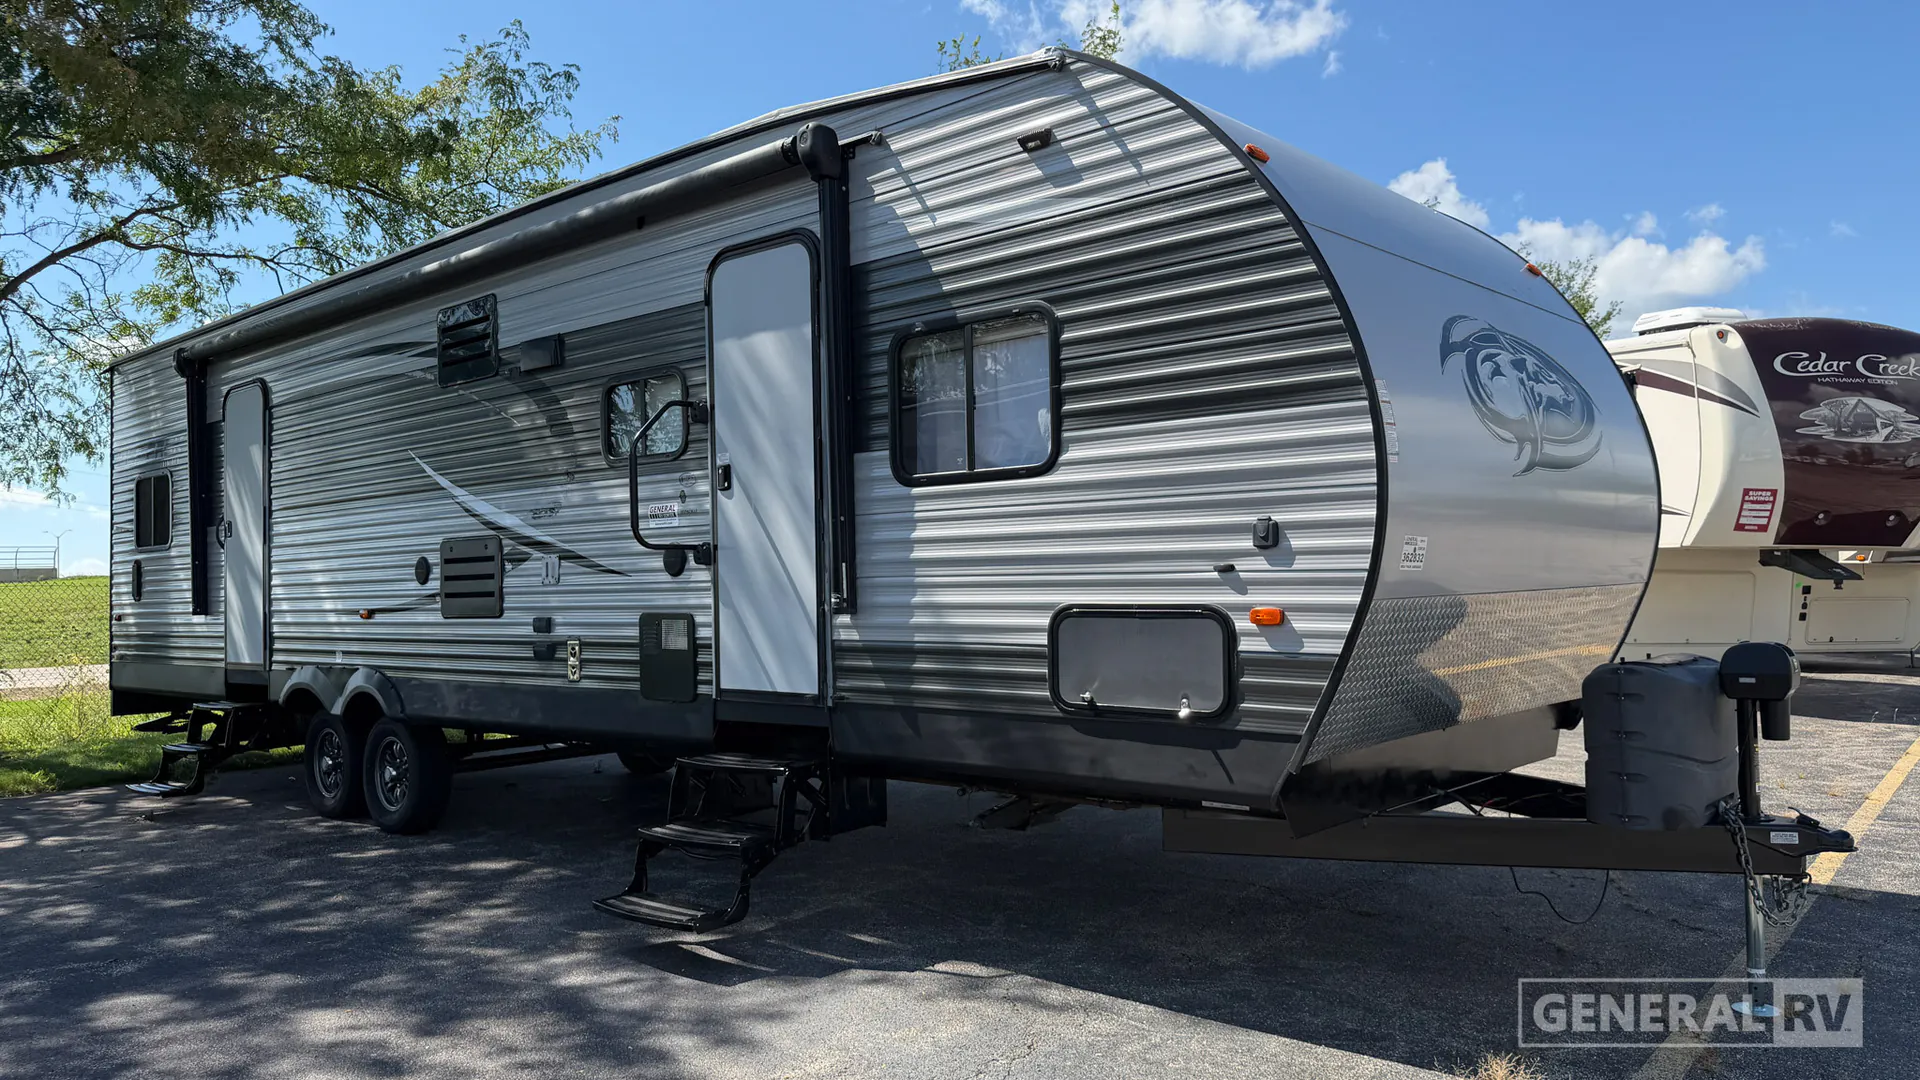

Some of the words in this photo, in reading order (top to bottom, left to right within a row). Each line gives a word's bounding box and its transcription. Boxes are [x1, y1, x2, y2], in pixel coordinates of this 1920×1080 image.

[1773, 351, 1851, 377] Cedar
[1856, 354, 1920, 380] Creek
[649, 504, 677, 514] GENERAL
[1401, 552, 1425, 563] 362832
